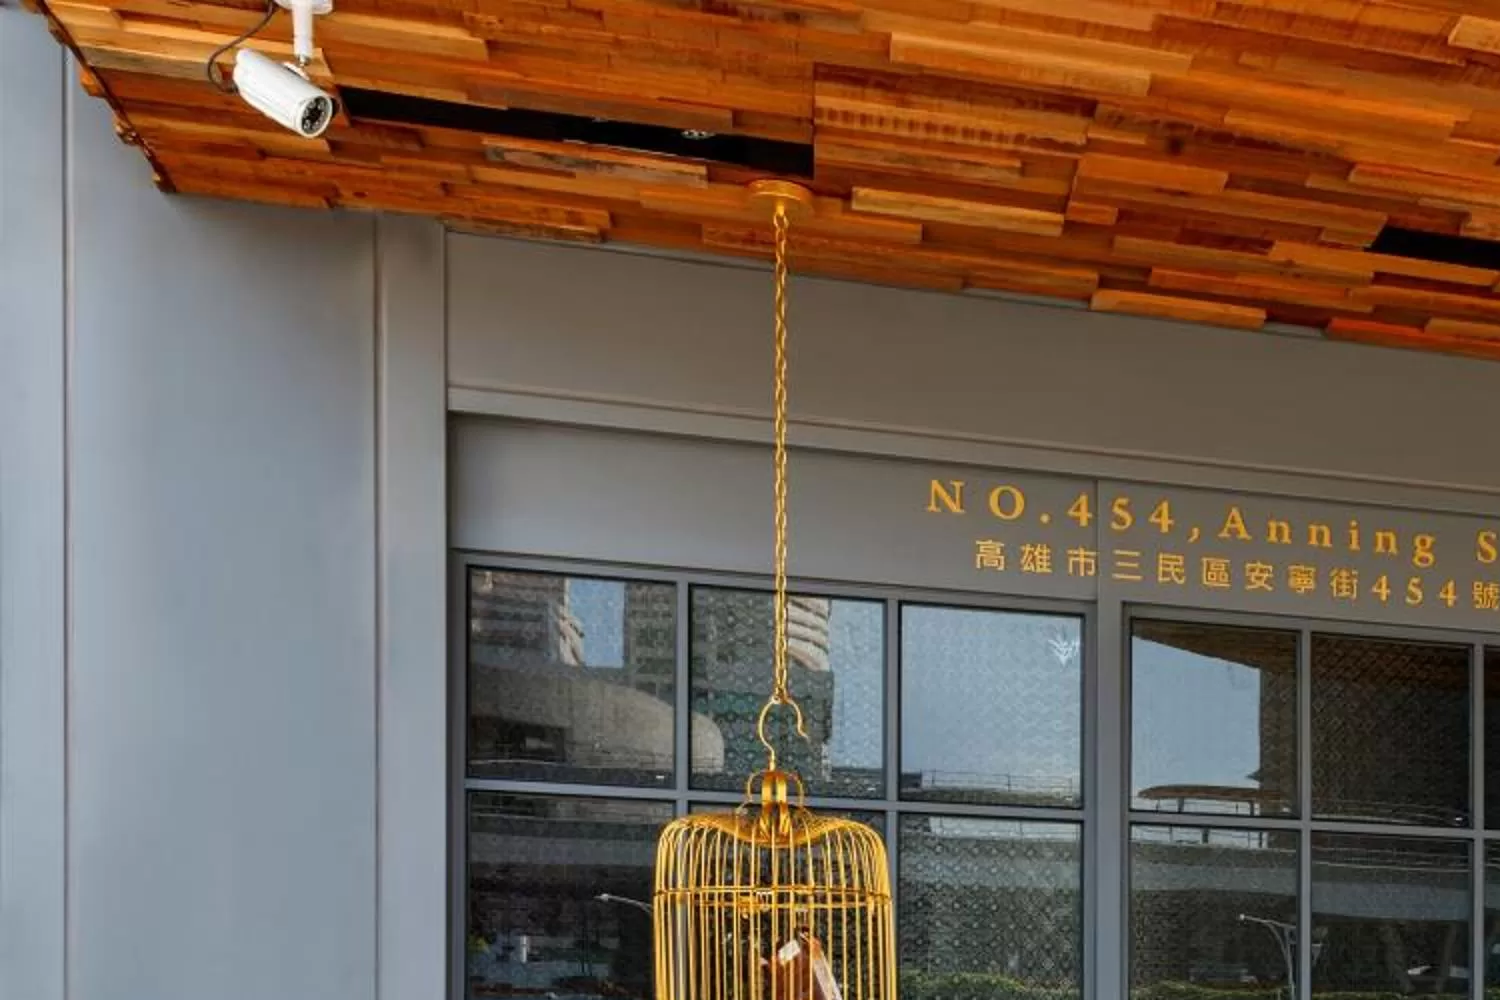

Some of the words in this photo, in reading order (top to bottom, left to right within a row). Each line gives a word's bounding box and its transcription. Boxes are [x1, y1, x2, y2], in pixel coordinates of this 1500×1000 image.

[976, 539, 1500, 611] 高雄市三民區安寧街454號
